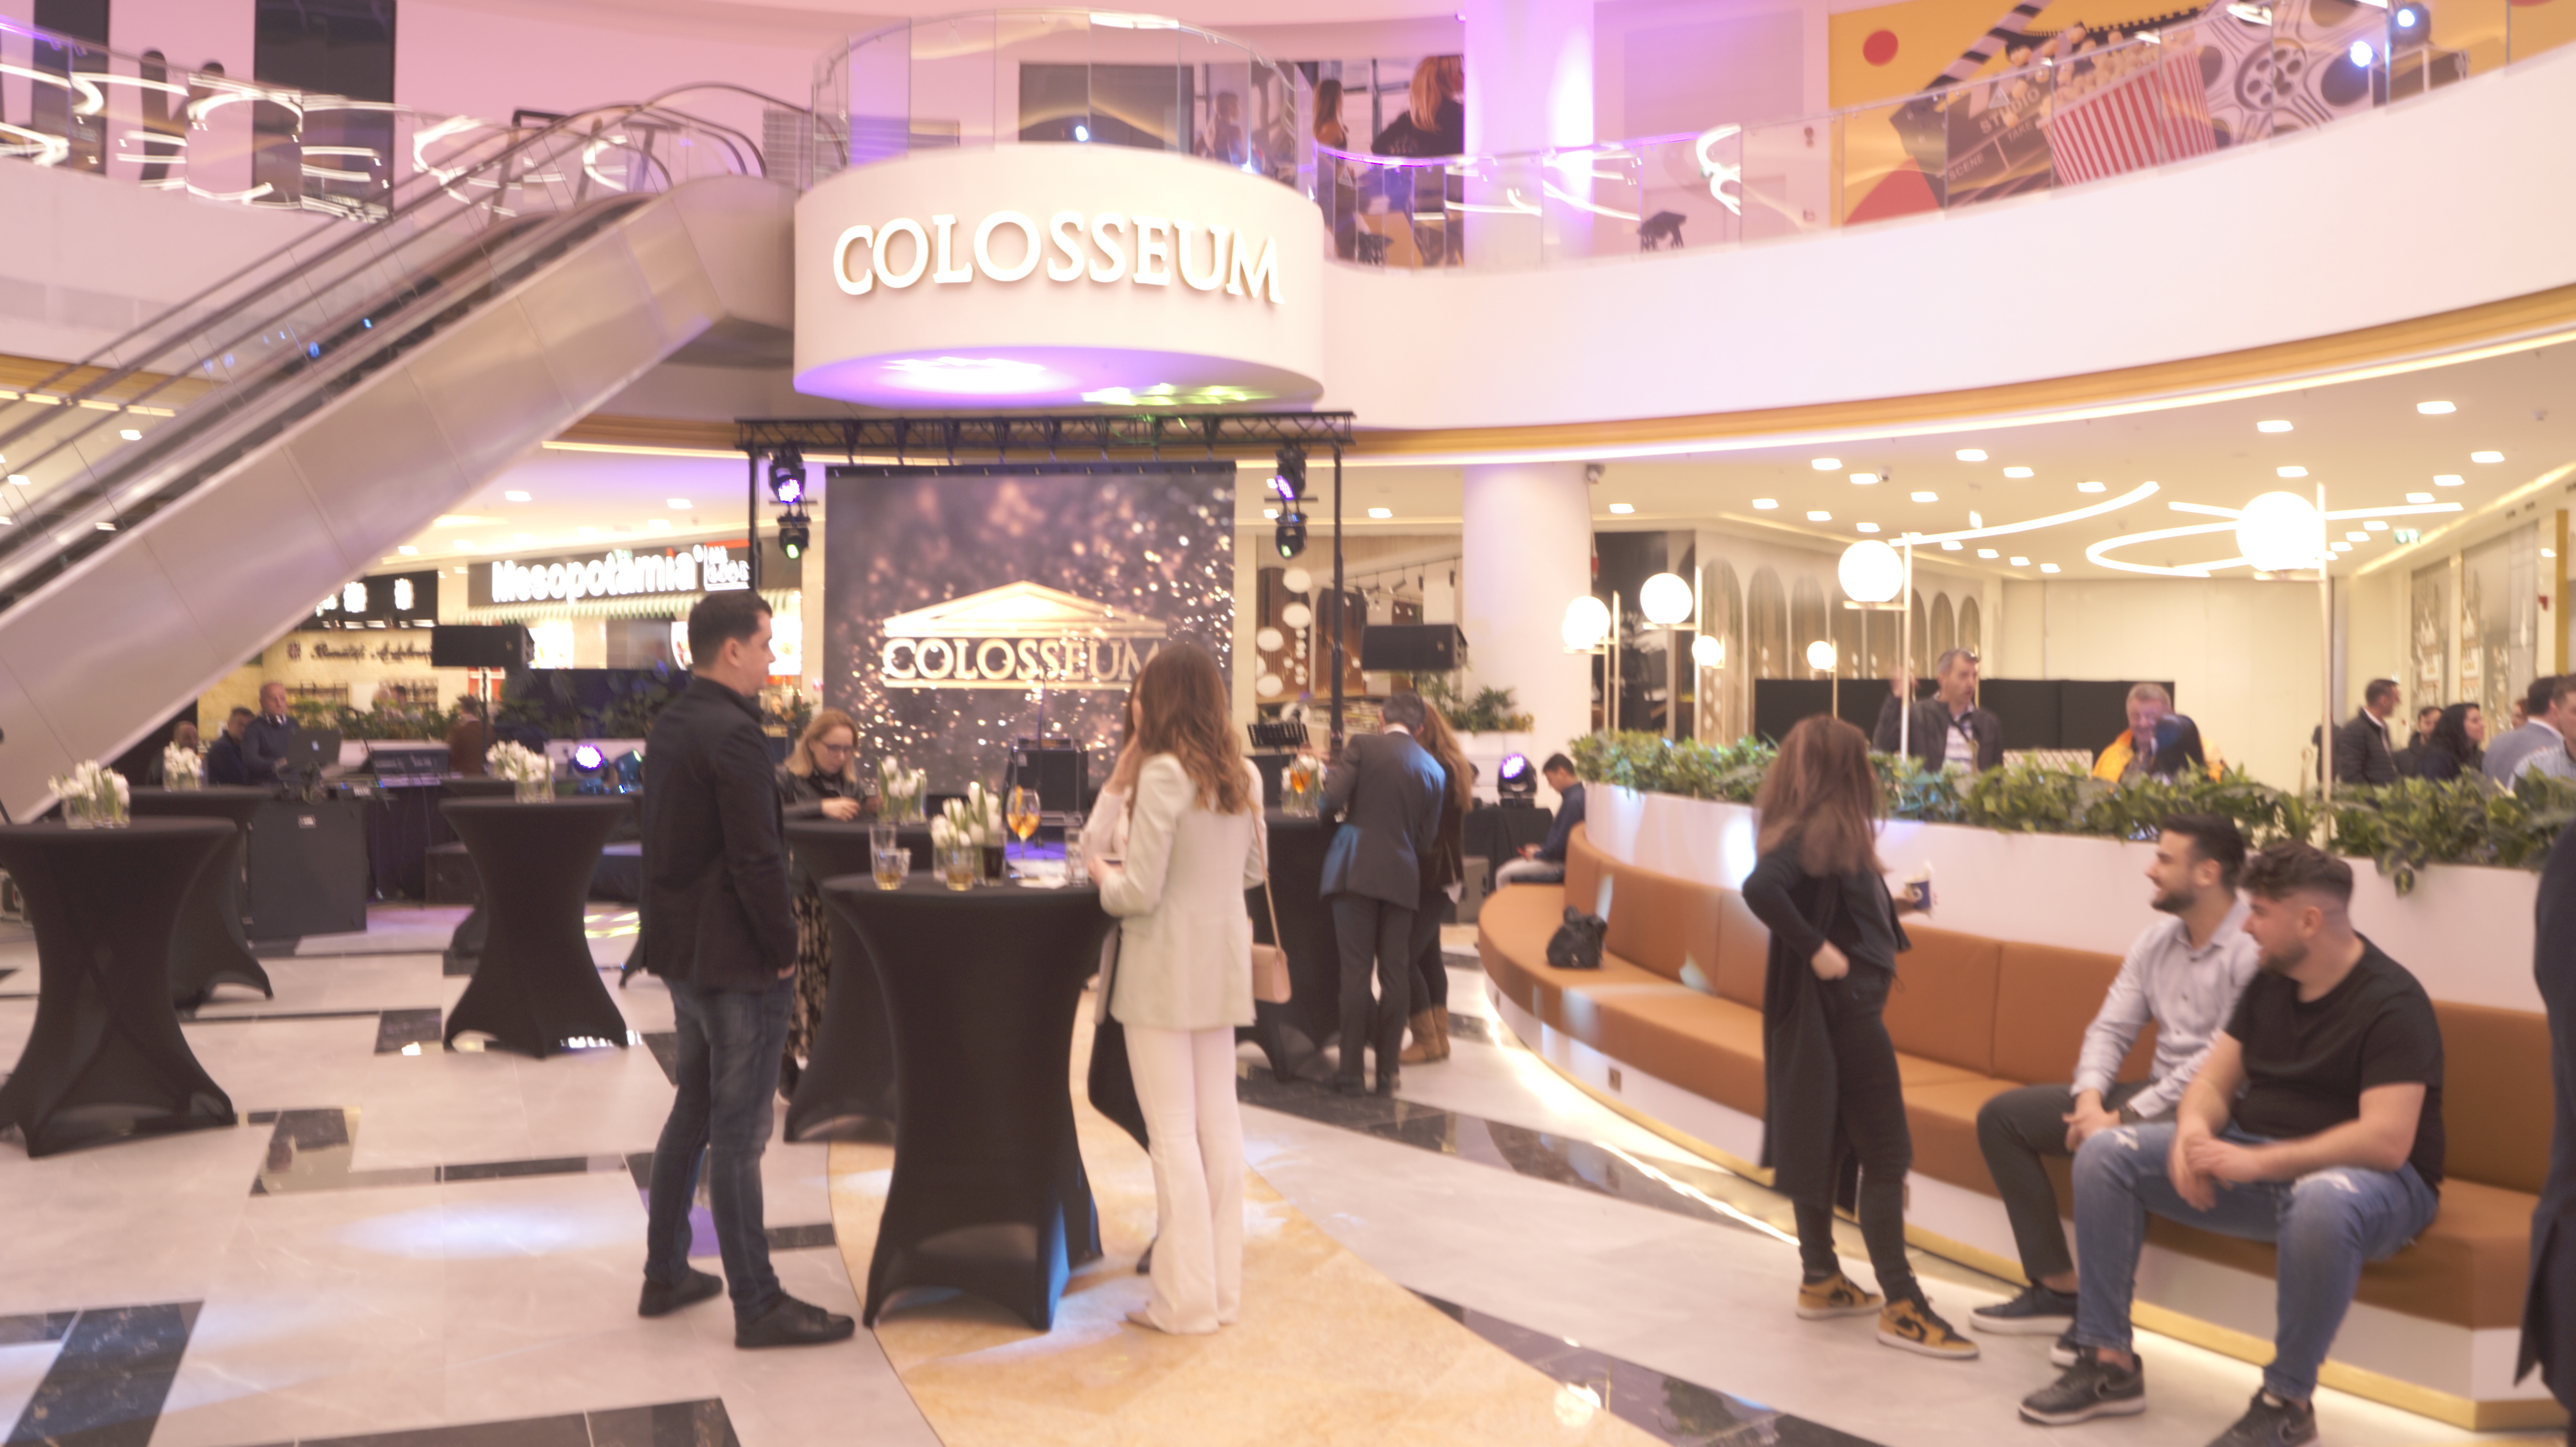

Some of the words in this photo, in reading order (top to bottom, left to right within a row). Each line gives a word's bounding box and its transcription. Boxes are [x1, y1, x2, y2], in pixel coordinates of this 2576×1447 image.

[1948, 152, 1985, 180] SCENE
[833, 210, 1284, 305] COLOSSEUM
[491, 548, 696, 606] Mesopotamia
